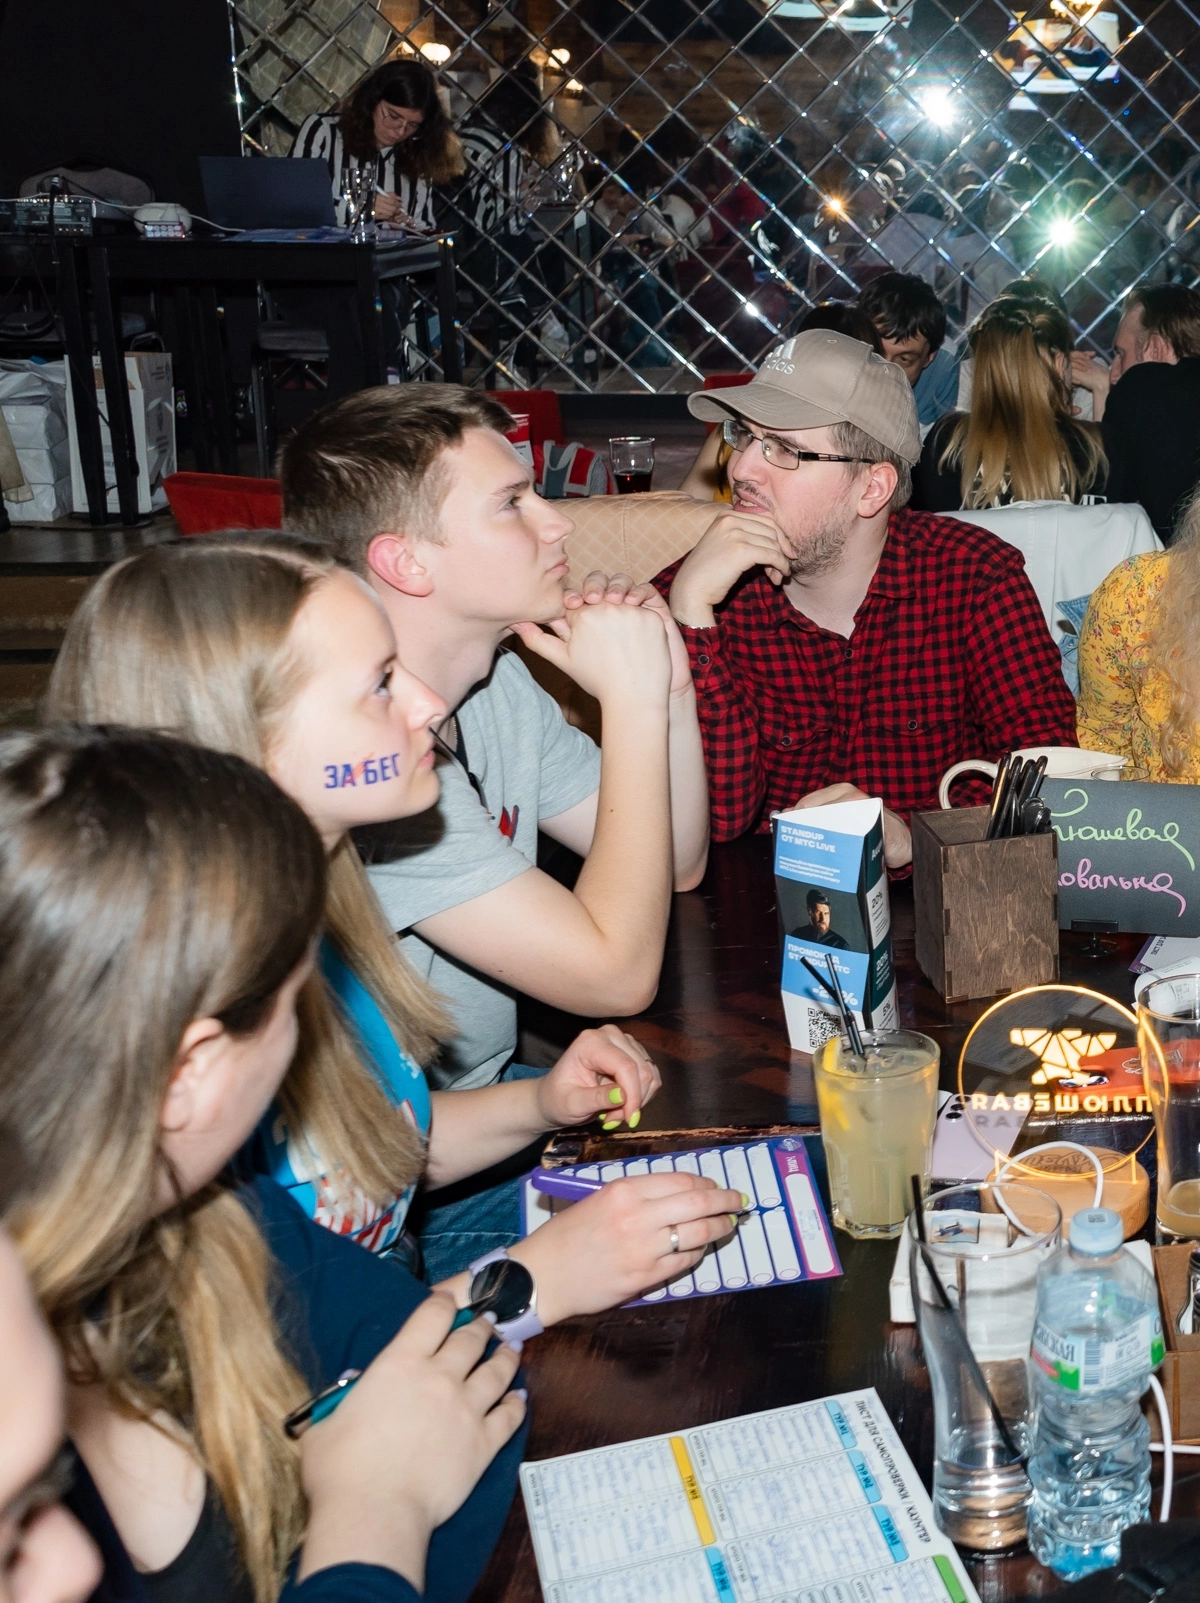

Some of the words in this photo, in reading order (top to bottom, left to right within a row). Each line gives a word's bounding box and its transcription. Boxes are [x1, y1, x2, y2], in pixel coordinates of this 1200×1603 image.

[780, 825, 825, 840] STANDUP
[781, 834, 794, 843] ОТ
[816, 842, 836, 853] LIVE
[788, 943, 840, 965] ПРОМОКД
[812, 984, 859, 1006] -2%
[855, 1399, 872, 1420] ЛИСТ
[864, 1418, 880, 1437] ДЛЯ
[872, 1434, 911, 1500] САМОПРОВЕРКИ
[906, 1504, 932, 1544] КАУНТЕР
